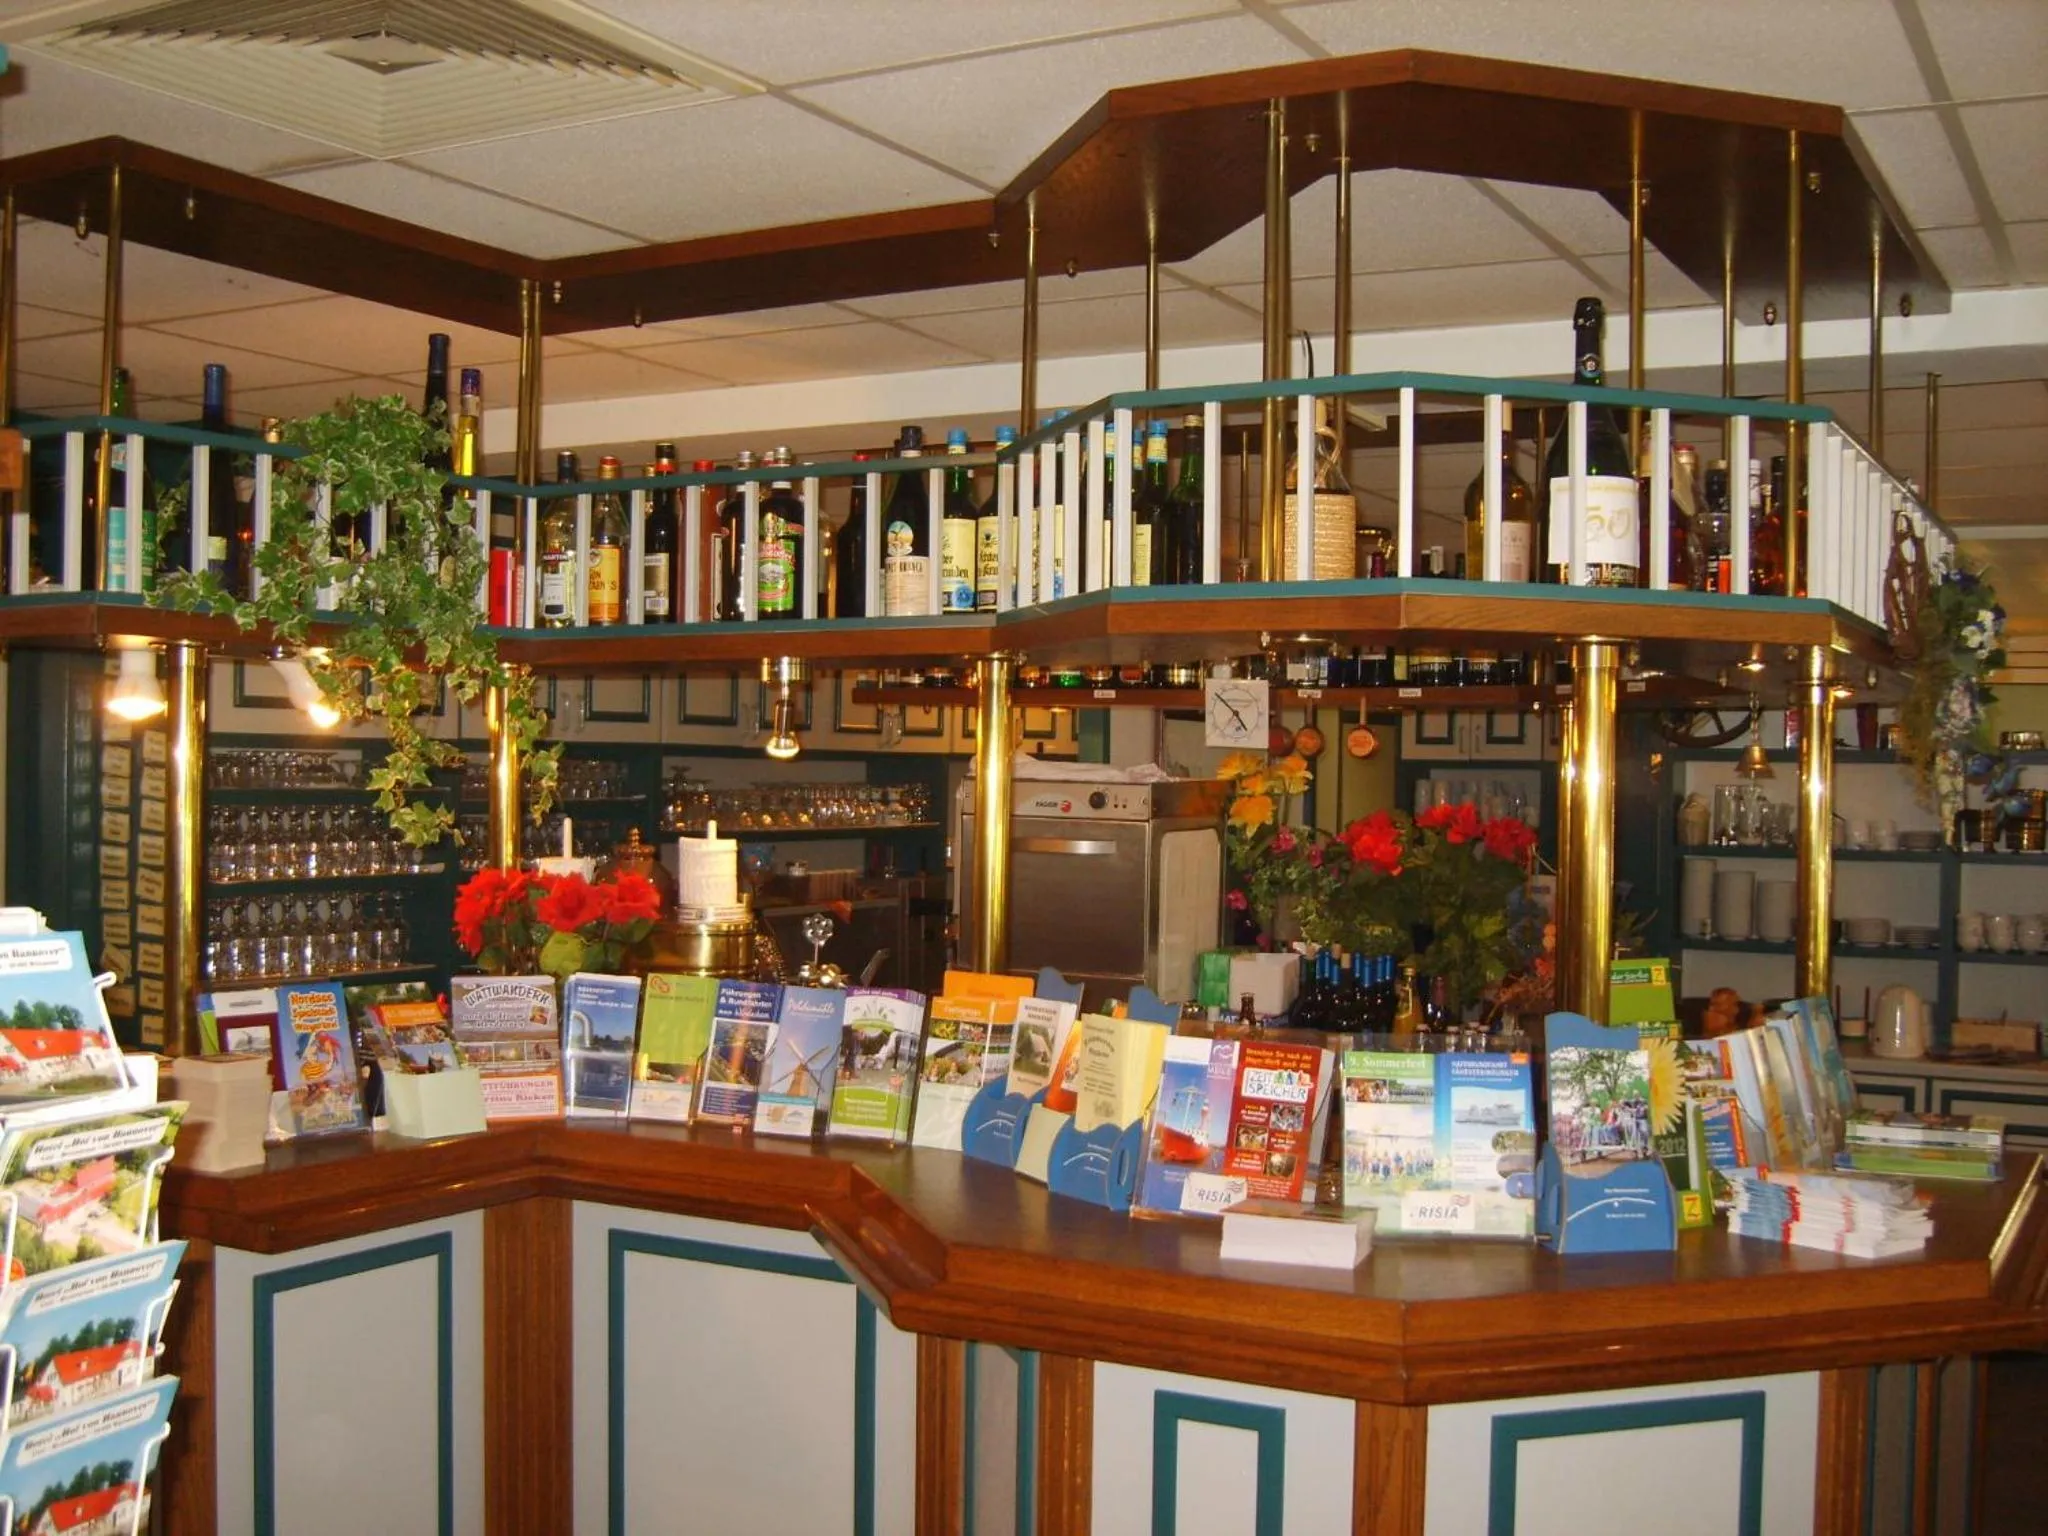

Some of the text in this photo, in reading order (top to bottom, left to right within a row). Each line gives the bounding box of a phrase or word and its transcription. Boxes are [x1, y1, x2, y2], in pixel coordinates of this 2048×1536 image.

[290, 993, 334, 1005] Nordsee
[466, 983, 551, 1007] WATTWANDERN
[720, 987, 762, 999] Führungen
[728, 996, 772, 1008] Rundfahrten
[1363, 1055, 1426, 1069] Sommerfest
[1249, 1070, 1273, 1083] ZEIT
[1248, 1083, 1306, 1100] SPEICHER
[1659, 1138, 1686, 1153] 2012
